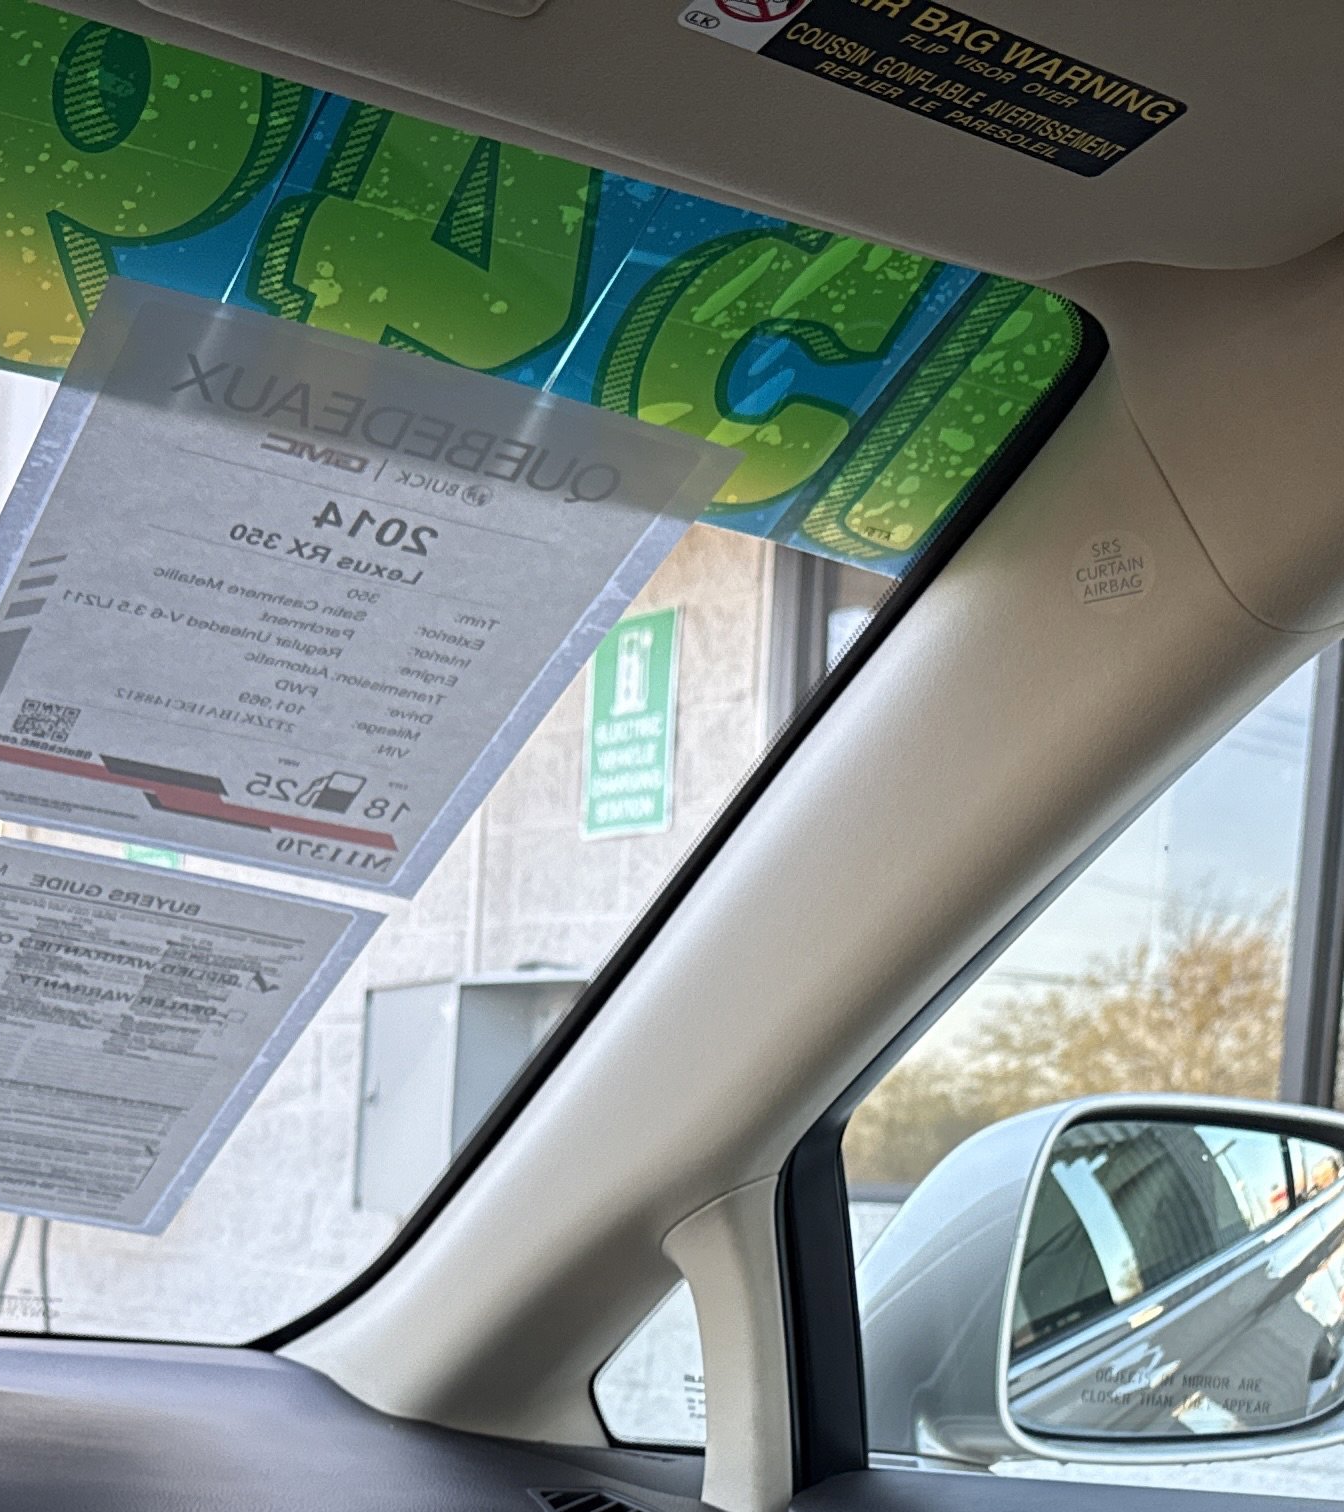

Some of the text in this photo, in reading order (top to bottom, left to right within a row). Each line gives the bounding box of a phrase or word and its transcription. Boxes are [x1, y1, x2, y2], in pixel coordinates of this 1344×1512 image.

[899, 33, 1079, 108] FLIP VISOR OVER
[911, 7, 1001, 55] BAG
[1001, 42, 1177, 125] WARNING
[786, 22, 1127, 161] COUSSIN GONFLABLE AVERTISSEMENT
[814, 60, 1062, 159] REPLIER LE PARESOLEIL
[1091, 537, 1122, 558] SRS
[1076, 557, 1144, 582] CURTAIN
[1084, 574, 1143, 598] AIRBAG
[1182, 1375, 1229, 1389] MIRROR
[1238, 1377, 1262, 1392] ARE
[1222, 1399, 1271, 1413] APPEAR
